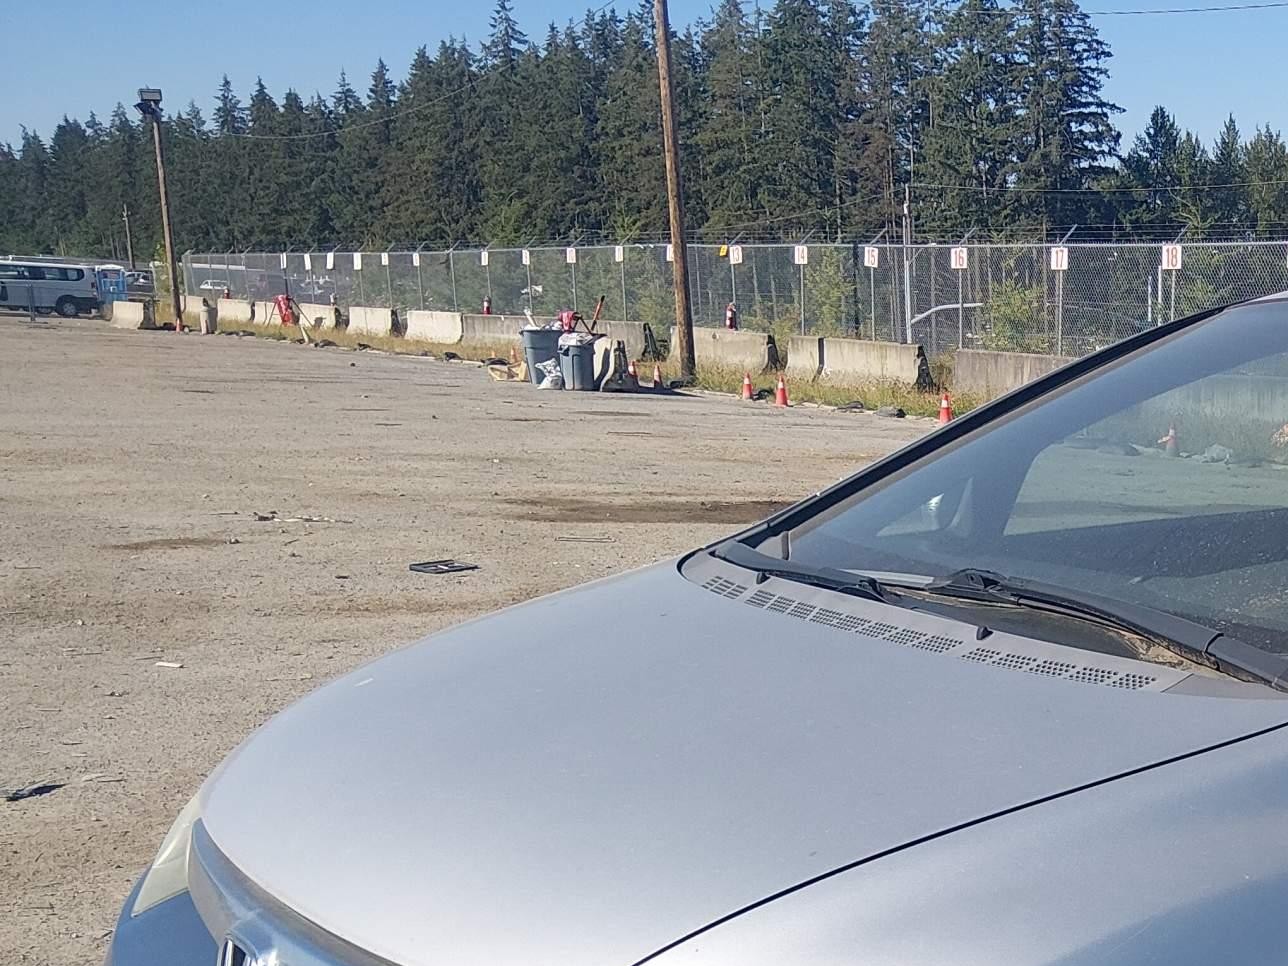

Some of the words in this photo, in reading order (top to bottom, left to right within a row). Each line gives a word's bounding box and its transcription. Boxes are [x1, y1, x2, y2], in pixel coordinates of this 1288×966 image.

[732, 247, 740, 262] 13
[796, 247, 805, 263] 14
[867, 248, 876, 266] 15
[954, 249, 965, 267] 16
[1055, 249, 1064, 268] 17
[1166, 247, 1178, 268] 18
